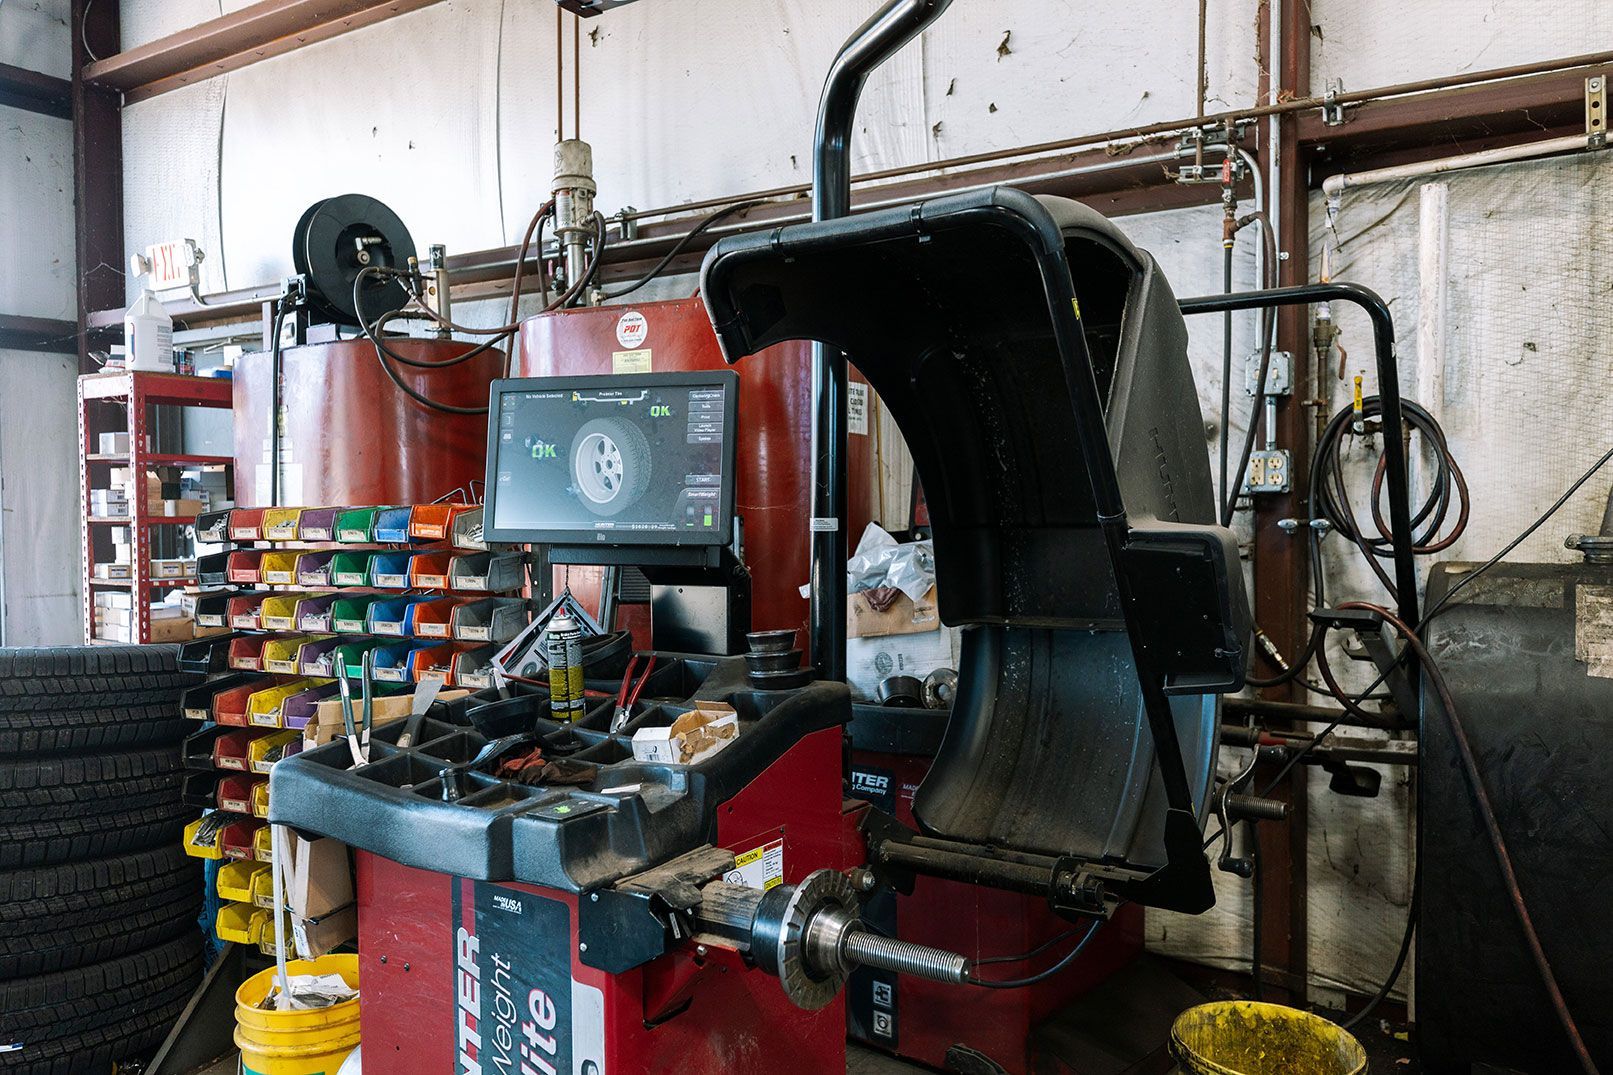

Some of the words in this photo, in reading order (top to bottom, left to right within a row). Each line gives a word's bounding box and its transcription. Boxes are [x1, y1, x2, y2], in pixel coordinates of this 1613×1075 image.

[650, 406, 671, 417] OK
[532, 444, 557, 458] OK
[856, 784, 887, 796] Company
[736, 852, 758, 866] CAUTION
[506, 898, 522, 912] USA
